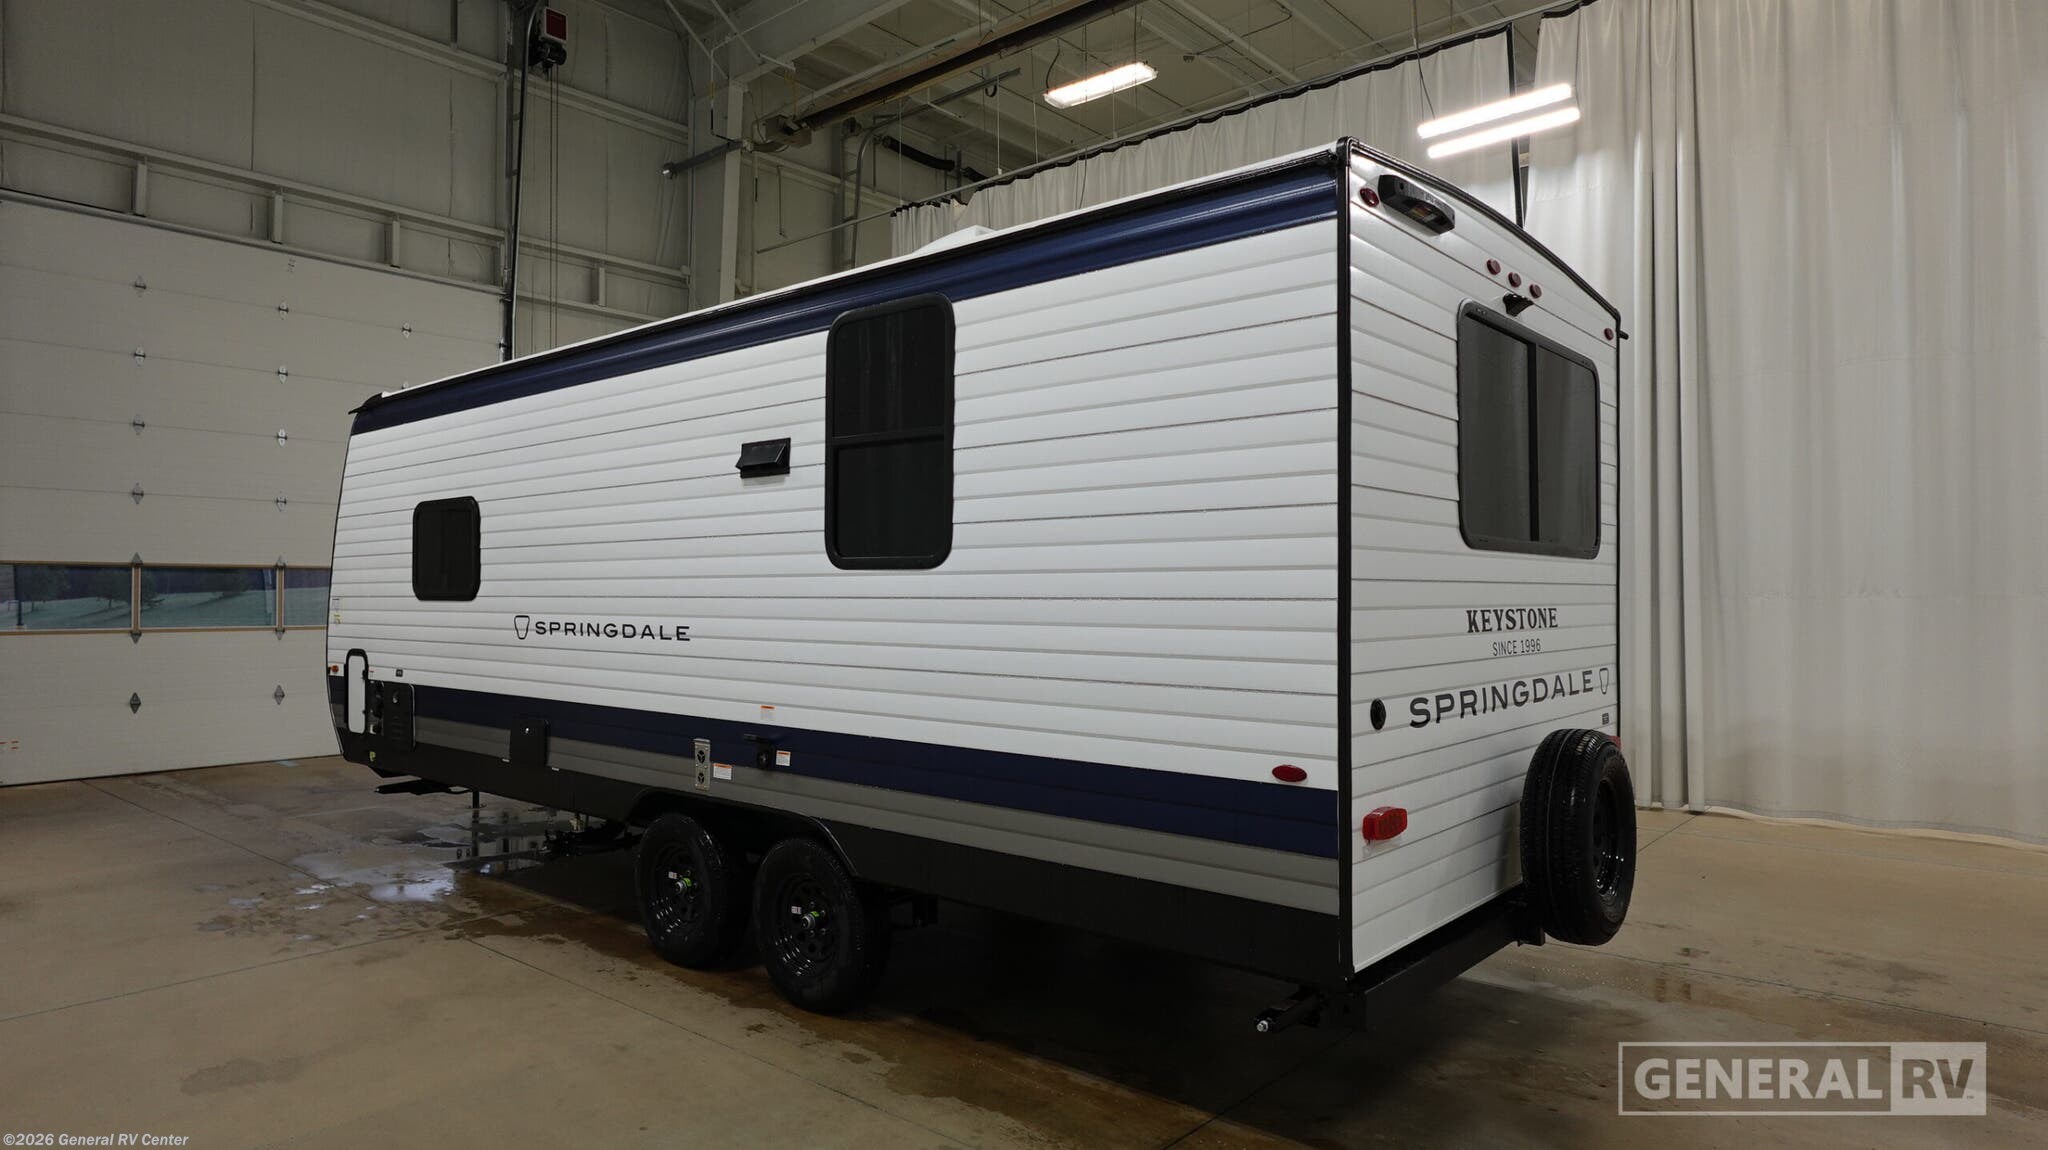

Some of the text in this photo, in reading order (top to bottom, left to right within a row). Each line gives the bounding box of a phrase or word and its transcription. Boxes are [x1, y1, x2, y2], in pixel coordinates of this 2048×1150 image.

[535, 621, 691, 642] SPRINGDALE
[1466, 607, 1558, 633] KEYSTONE
[1492, 638, 1541, 656] SINCE 1996
[1409, 670, 1594, 728] SPRINGDALE
